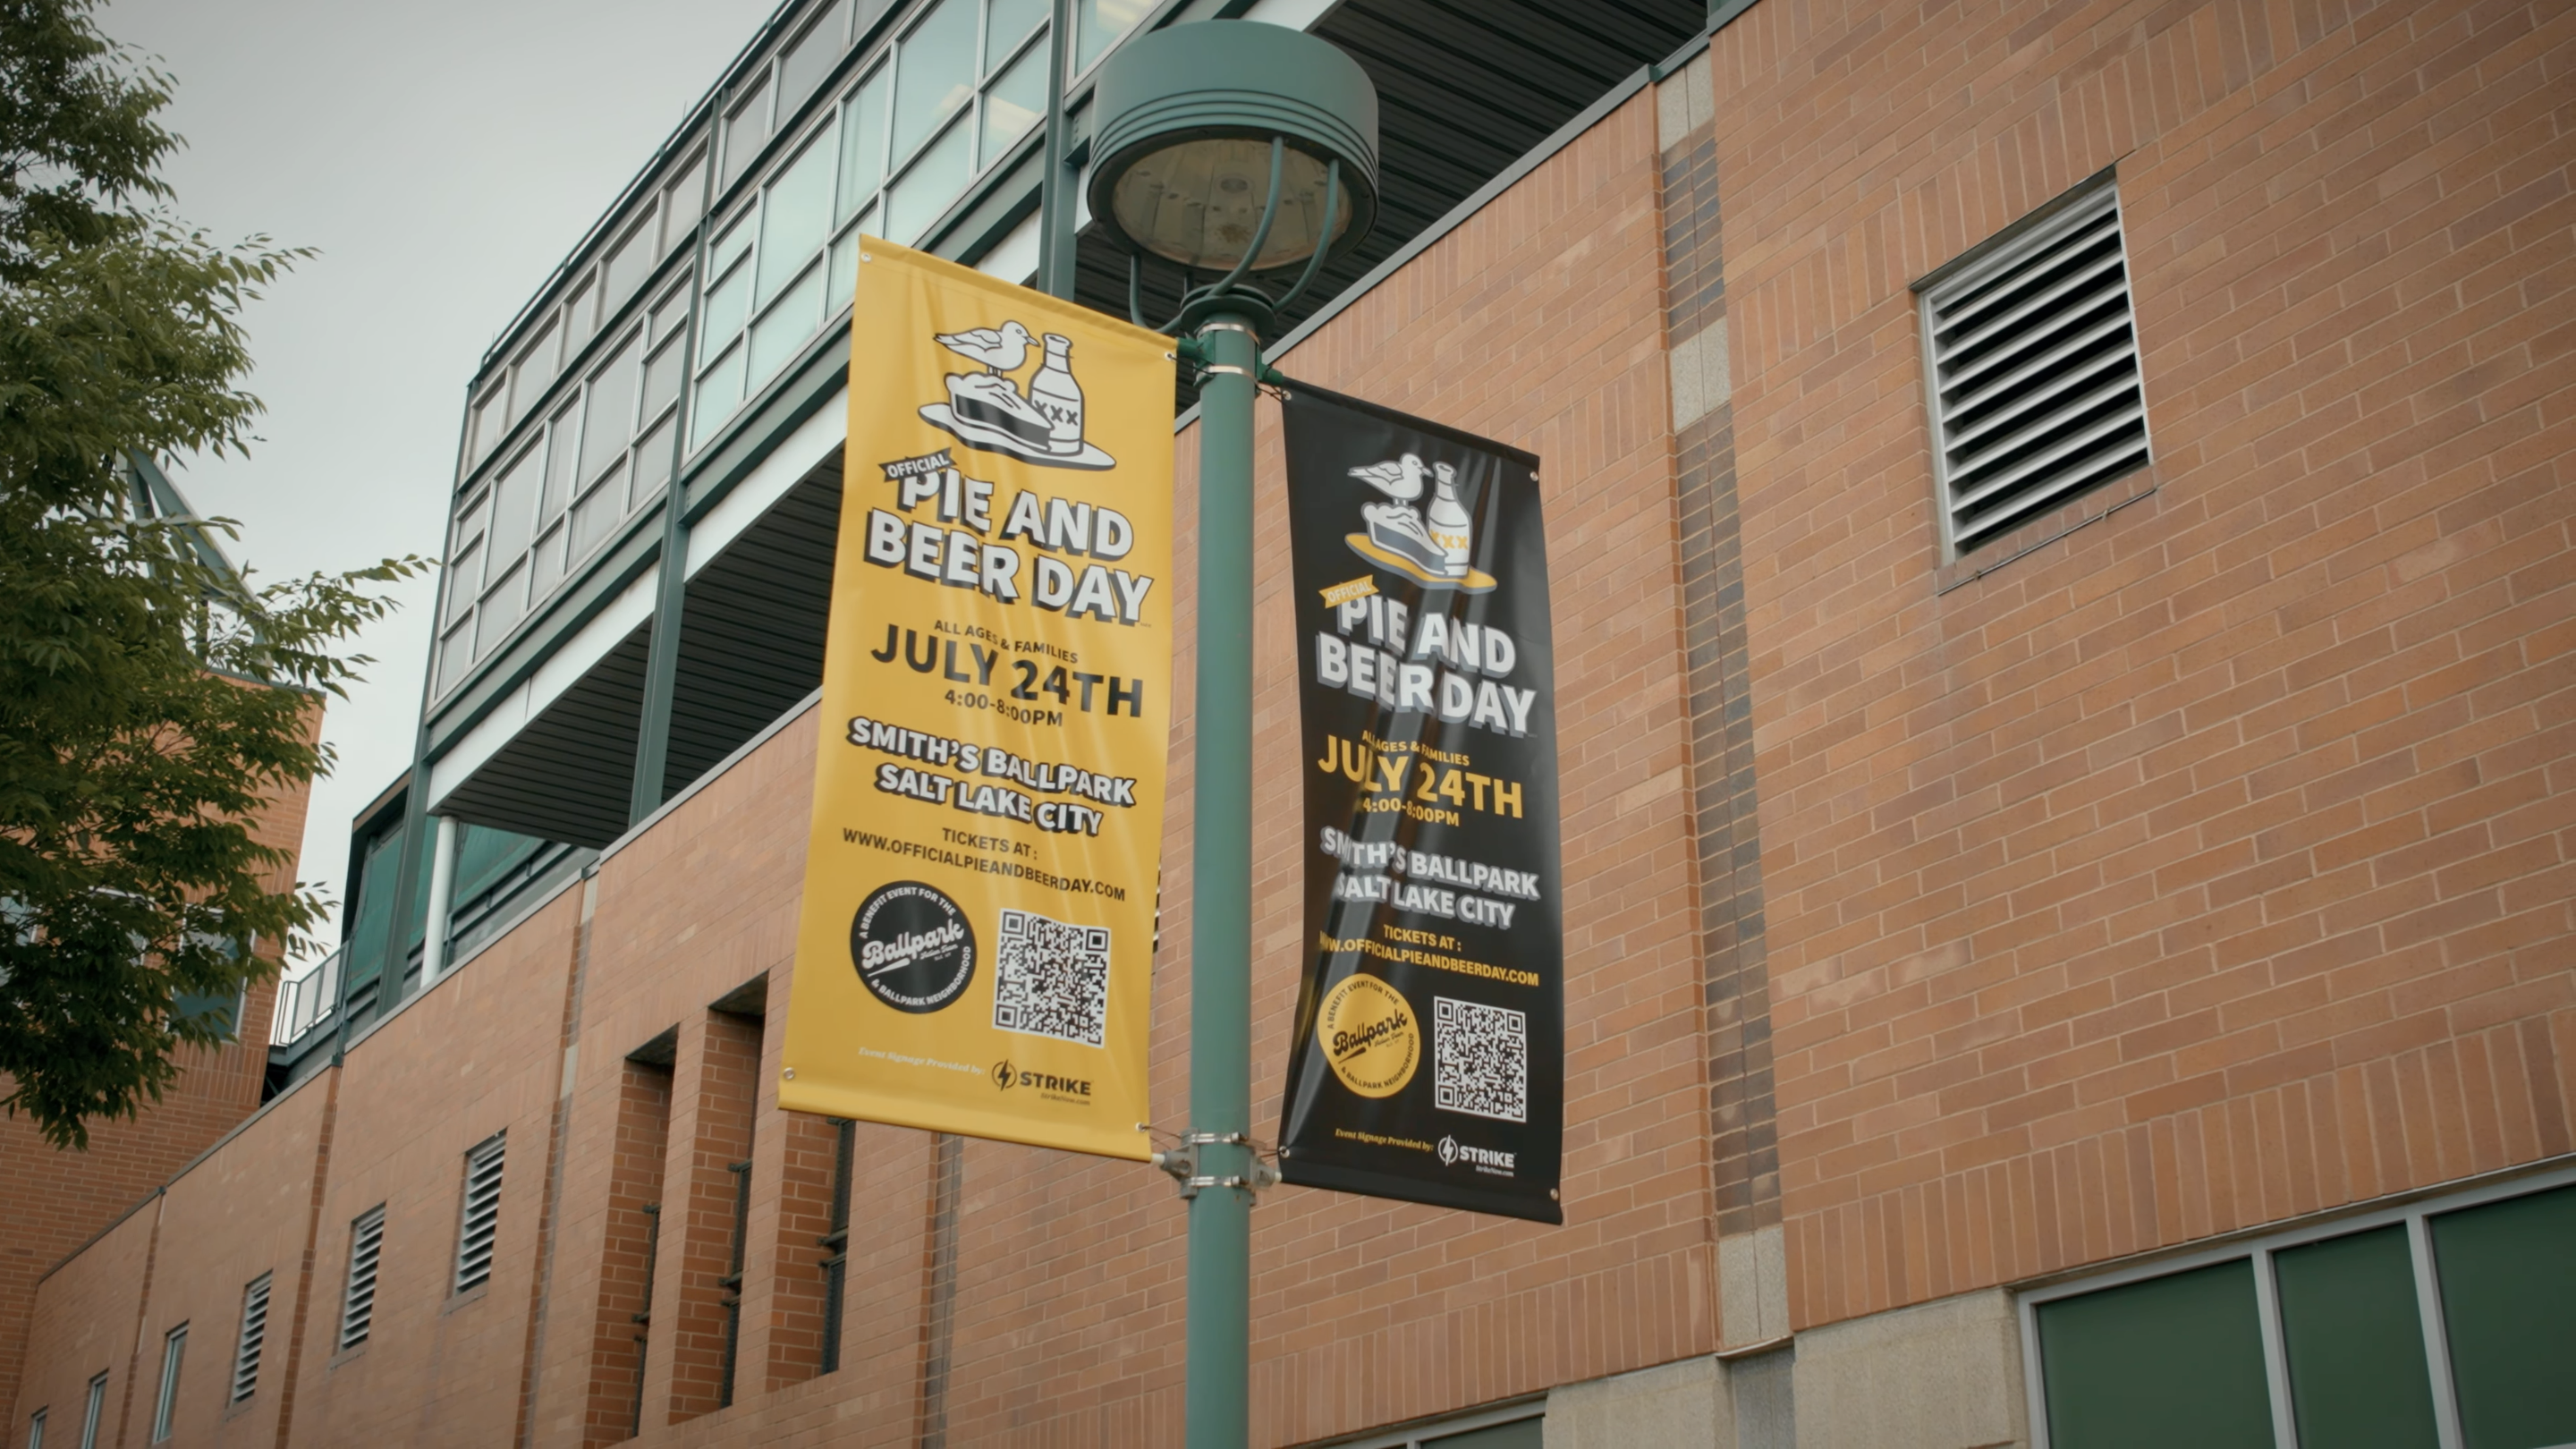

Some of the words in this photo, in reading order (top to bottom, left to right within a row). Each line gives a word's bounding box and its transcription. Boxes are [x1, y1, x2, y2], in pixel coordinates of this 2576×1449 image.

[886, 453, 950, 478] OFFICIAL
[898, 467, 995, 534] PIE
[999, 488, 1134, 562] AND
[864, 506, 1021, 605] BEER
[1032, 554, 1155, 625] DAY
[1327, 580, 1372, 604] OFFICIAL
[935, 619, 962, 637] ALL
[965, 624, 999, 647] AGES
[1000, 639, 1011, 651] &
[1014, 640, 1080, 665] FAMILIES
[1337, 594, 1409, 655] PIE
[1411, 612, 1516, 678] AND
[870, 623, 1000, 687] JULY
[1011, 658, 1144, 718] 24TH
[1316, 631, 1435, 714] BEER
[1438, 670, 1538, 738] DAY
[944, 689, 1064, 728] 4:00-8:00PM
[846, 716, 981, 773] SMITH'S
[982, 747, 1137, 807] BALLPARK
[1361, 729, 1376, 747] ALL
[1376, 738, 1408, 753] AGES
[1410, 740, 1420, 752] &
[1421, 744, 1470, 767] FAMILIES
[1318, 734, 1410, 792] JULY
[1416, 762, 1523, 819] 24TH
[875, 763, 953, 805] SALT
[954, 781, 1033, 824] LAKE
[1034, 802, 1104, 836] CITY
[1362, 798, 1461, 827] 4:00-8:00PM
[942, 826, 1011, 853] TICKETS
[843, 826, 1126, 902] WWW.OFFICIALPIEANDBEERDAY.COM
[1408, 850, 1541, 900] BALLPARK
[860, 894, 888, 930] BENEFIT
[886, 886, 918, 901] EVENT
[918, 887, 939, 902] FOR
[938, 897, 957, 916] THE
[1332, 871, 1392, 903] SALT
[1391, 880, 1456, 919] LAKE
[1456, 895, 1516, 930] CITY
[860, 930, 869, 939] A
[861, 918, 965, 970] Ballpark
[1383, 923, 1436, 948] TICKETS
[878, 984, 927, 1006] BALLPARK
[925, 945, 972, 1005] NEIGHBORHOOD
[1327, 989, 1349, 1022] BENEFIT
[1348, 980, 1368, 992] EVENT
[1368, 981, 1384, 994] FOR
[1385, 990, 1400, 1005] THE
[1333, 1008, 1408, 1056] Ballpark
[859, 1046, 886, 1059] Event
[887, 1051, 926, 1066] Signage
[926, 1057, 970, 1072] Provided
[1346, 1072, 1384, 1089] BALLPARK
[1384, 1032, 1415, 1088] NEIGHBORHOOD
[1020, 1071, 1092, 1097] STRIKE
[1335, 1128, 1357, 1140] Event
[1357, 1131, 1387, 1145] Signage
[1387, 1136, 1422, 1150] Provided
[1460, 1145, 1515, 1168] STRIKE
